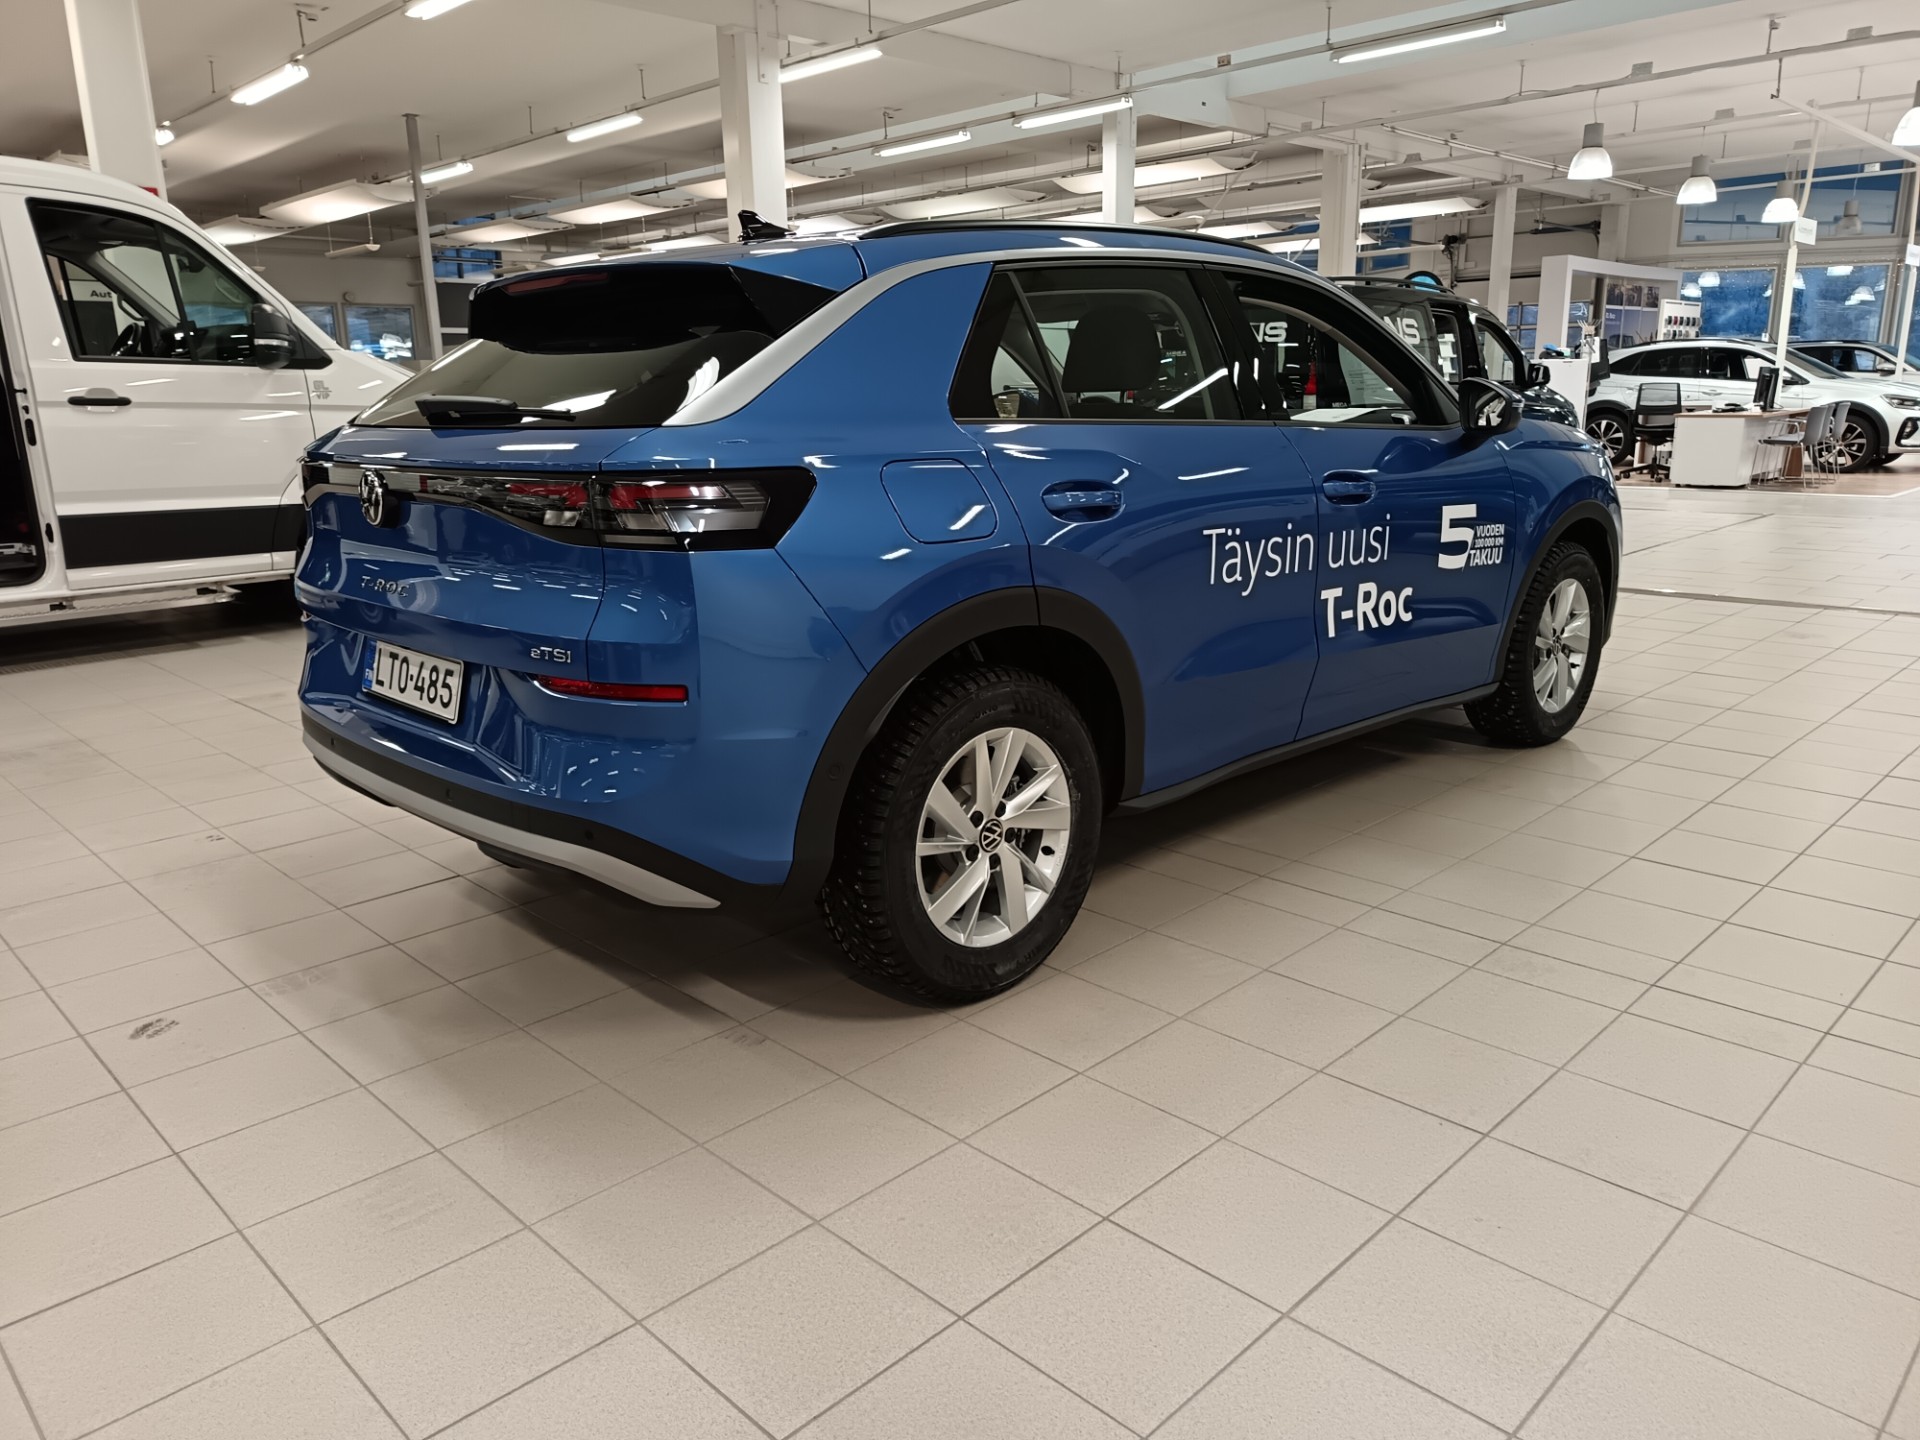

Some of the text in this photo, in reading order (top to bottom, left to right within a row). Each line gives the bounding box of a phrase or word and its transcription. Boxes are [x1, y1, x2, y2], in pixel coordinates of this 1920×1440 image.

[1202, 513, 1391, 596] Täysin uusi
[1437, 503, 1477, 570] 5
[1469, 547, 1503, 567] TAKUU
[1476, 523, 1505, 537] VUODEN
[361, 575, 409, 597] T-ROC
[1320, 581, 1413, 638] T-Roc
[375, 647, 455, 709] LTO-485
